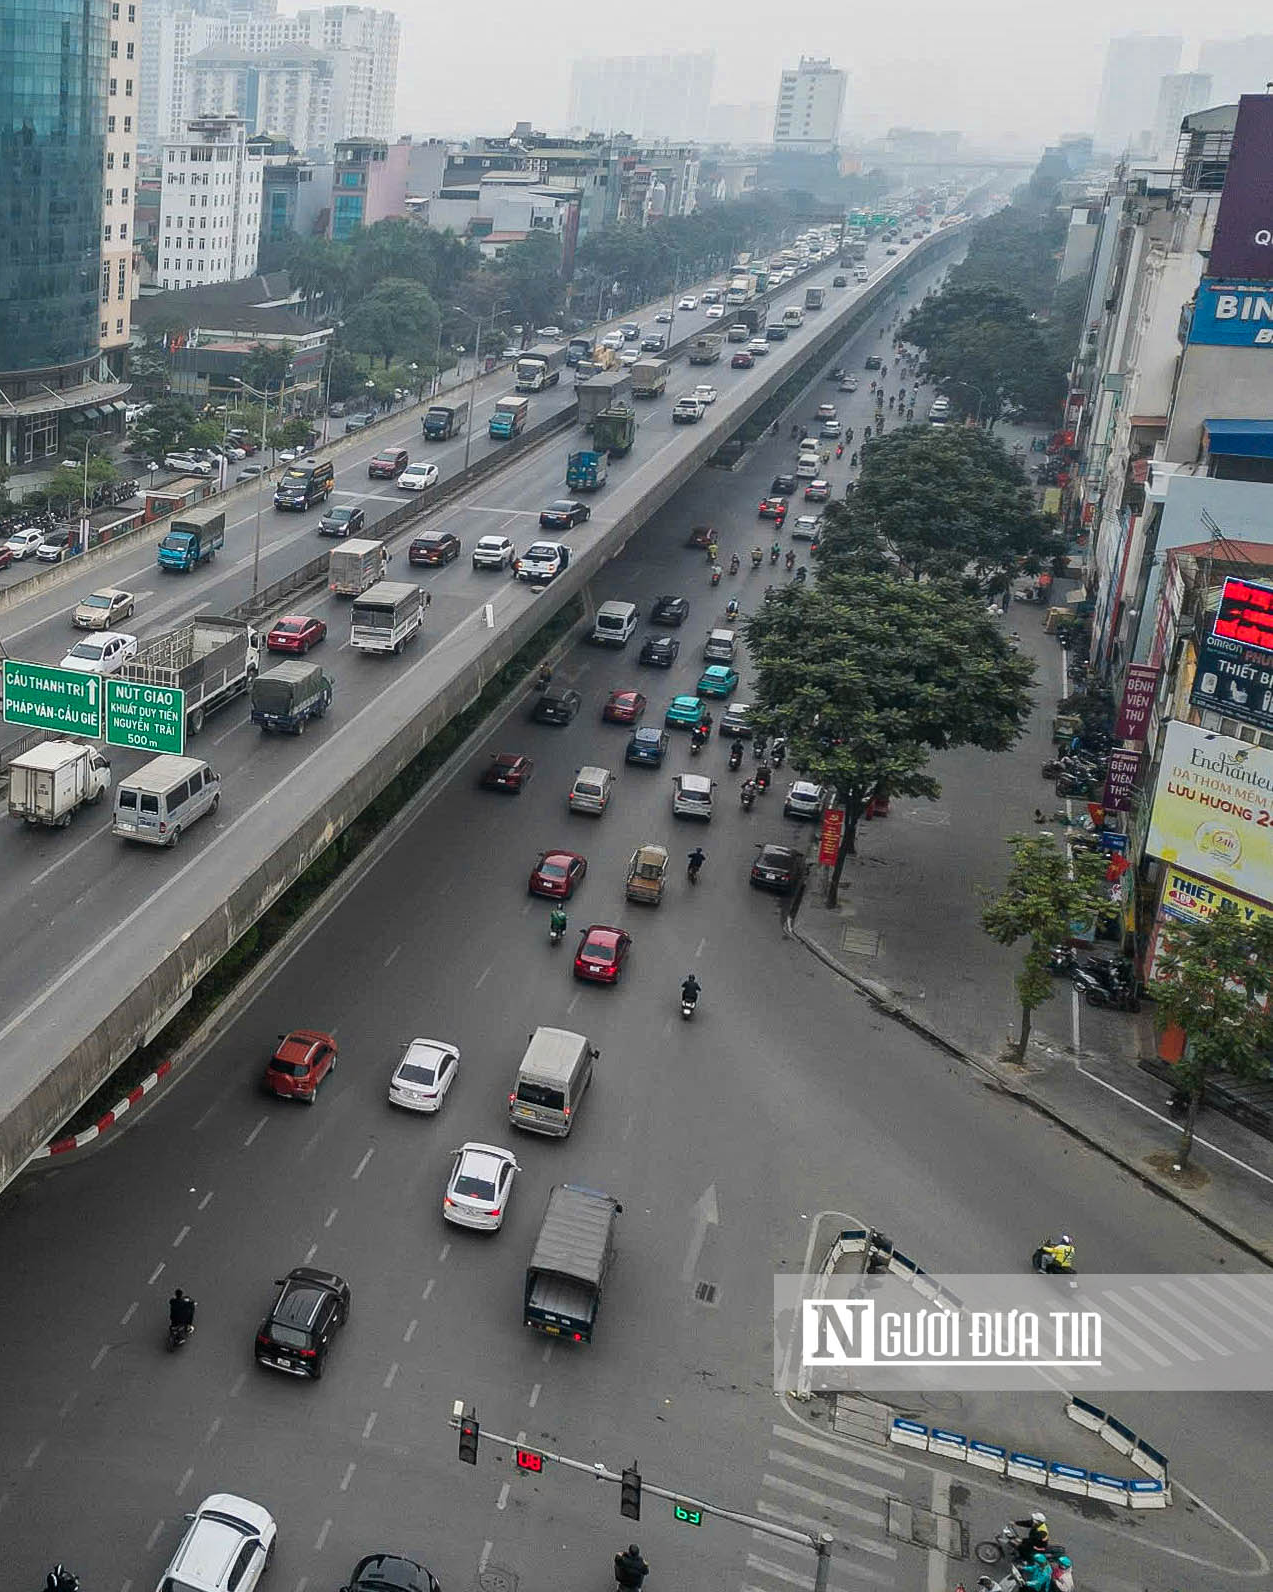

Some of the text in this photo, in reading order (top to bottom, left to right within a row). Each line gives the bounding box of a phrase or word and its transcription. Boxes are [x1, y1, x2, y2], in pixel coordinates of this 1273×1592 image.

[1255, 230, 1273, 246] Q
[1254, 328, 1273, 343] B
[1218, 659, 1258, 680] THIẾT
[29, 676, 65, 694] THANH
[1127, 678, 1154, 693] BỆNH
[116, 685, 173, 706] NÚT GIAO
[1127, 693, 1150, 707] VIỆN
[139, 707, 156, 719] DUY
[159, 707, 178, 721] TIẾN
[1129, 725, 1135, 735] Y
[128, 733, 147, 745] 500
[1111, 760, 1137, 773] BỆNH
[1257, 810, 1273, 827] 2
[1172, 875, 1216, 904] THIẾT
